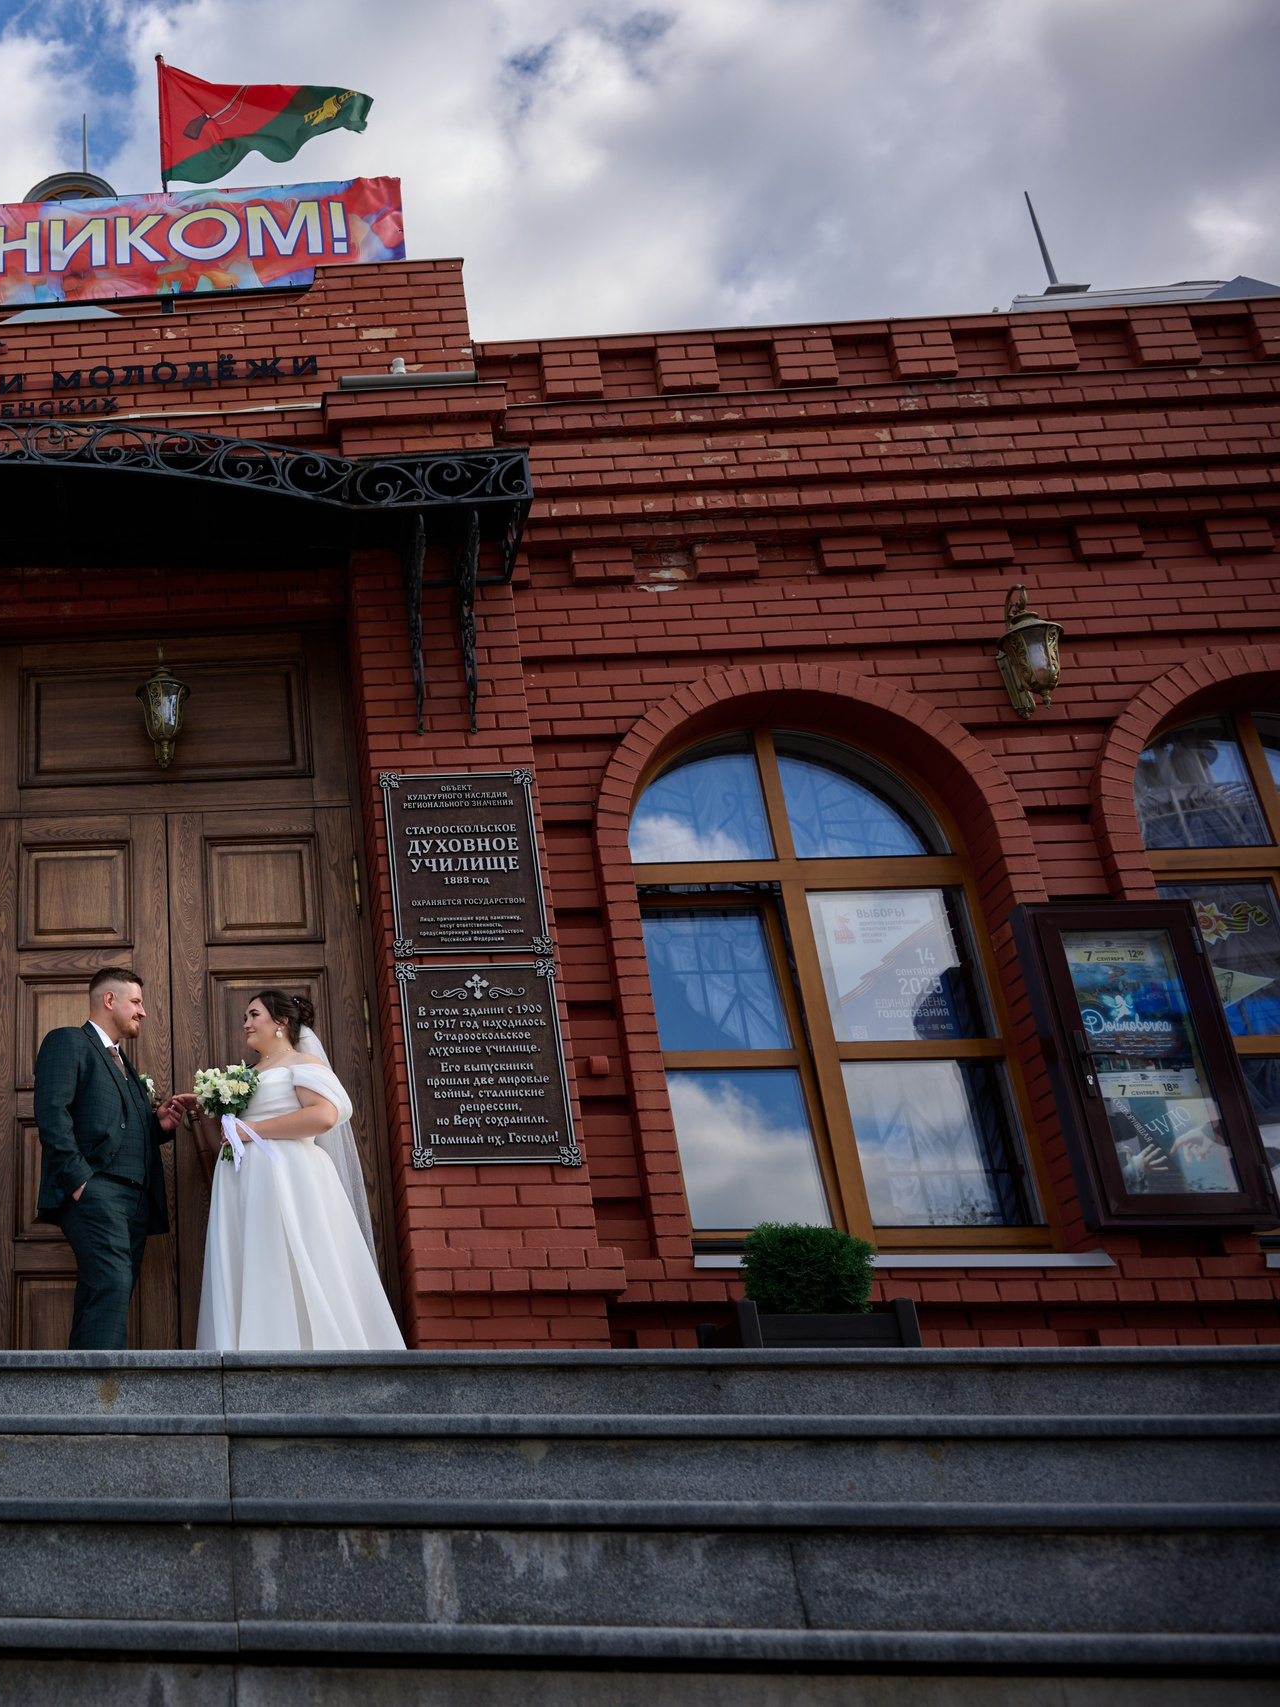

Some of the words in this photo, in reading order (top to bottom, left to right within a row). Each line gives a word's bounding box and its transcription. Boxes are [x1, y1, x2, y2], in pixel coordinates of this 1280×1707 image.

[0, 373, 22, 395] И
[52, 353, 317, 390] МОЛОДЁЖИ
[440, 784, 472, 792] ОБЪЕКТ
[407, 793, 463, 801] КУЛЬТУРНОГО
[465, 791, 508, 799] НАСЛЕДИЯ
[403, 801, 470, 809] РЕГИОНАЛЬНОГО
[472, 799, 514, 807] ЗНАЧЕНИЯ
[405, 823, 517, 835] СТАРООСКОЛЬСКОЕ
[407, 836, 520, 857] ДУХОВНОЕ
[410, 856, 520, 873] УЧИЛИЩЕ
[443, 876, 470, 885] 1888
[472, 877, 490, 885] год
[411, 899, 462, 907] ОХРАНЯЕТСЯ
[464, 897, 526, 905] ГОСУДАРСТВОМ
[856, 908, 905, 918] ВЫБОРЫ
[915, 947, 935, 965] 14
[1083, 951, 1092, 962] 7
[895, 966, 939, 976] сентября
[898, 976, 943, 995] 2025
[874, 996, 918, 1009] ЕДИНЫЙ
[921, 997, 947, 1008] ДЕНЬ
[418, 1006, 426, 1017] В
[429, 1007, 459, 1017] этом
[462, 1006, 504, 1017] здании
[507, 1006, 513, 1014] с
[516, 1004, 543, 1014] 1900
[416, 1021, 429, 1029] по
[432, 1019, 456, 1029] 1917
[459, 1020, 480, 1030] год
[482, 1018, 546, 1030] находилось
[434, 1031, 531, 1044] Старооскольское
[428, 1045, 482, 1057] духовное
[484, 1044, 541, 1056] училище.
[440, 1062, 460, 1073] Его
[463, 1062, 534, 1075] выпускники
[426, 1076, 470, 1089] прошли
[473, 1076, 495, 1087] две
[497, 1075, 549, 1087] мировые
[434, 1089, 474, 1100] войны,
[477, 1088, 545, 1098] сталинские
[1117, 1084, 1127, 1096] 7
[459, 1103, 523, 1114] репрессии,
[436, 1116, 450, 1126] но
[453, 1114, 481, 1128] Веру
[484, 1115, 549, 1128] сохранили.
[1112, 1098, 1153, 1143] СОТВОРИВШАЯ
[1145, 1106, 1191, 1135] ЧУДО
[429, 1133, 484, 1145] Поминай
[487, 1136, 505, 1147] их,
[507, 1131, 559, 1145] Господи!
